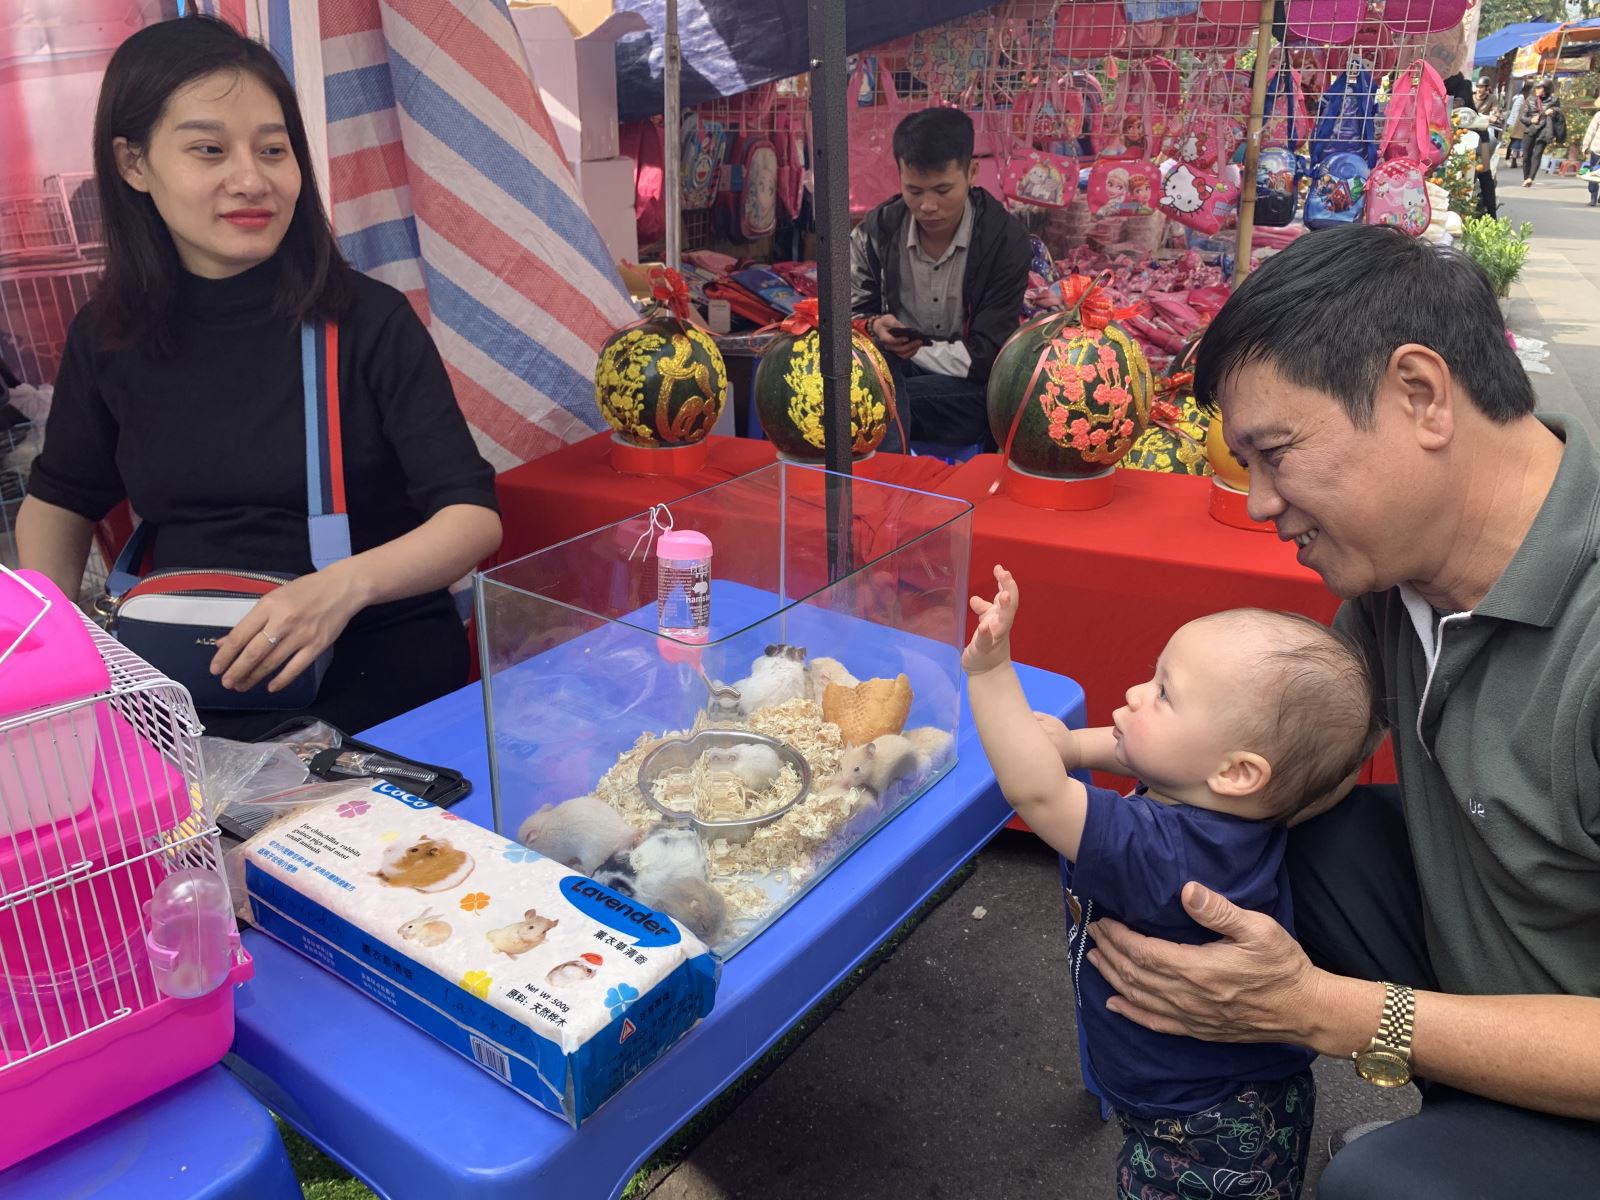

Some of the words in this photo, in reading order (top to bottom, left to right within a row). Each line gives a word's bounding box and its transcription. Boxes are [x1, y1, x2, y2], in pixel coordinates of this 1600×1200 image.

[685, 595, 710, 603] hamste
[196, 637, 217, 646] ALD
[379, 783, 429, 807] CoCo
[285, 833, 302, 843] small
[299, 840, 321, 854] animals
[292, 828, 312, 840] guinea
[310, 837, 323, 846] pigs
[322, 844, 336, 852] and
[333, 850, 350, 860] most
[300, 823, 312, 831] for
[340, 844, 362, 857] rabbits
[571, 879, 671, 936] Lavender
[525, 983, 540, 994] Net
